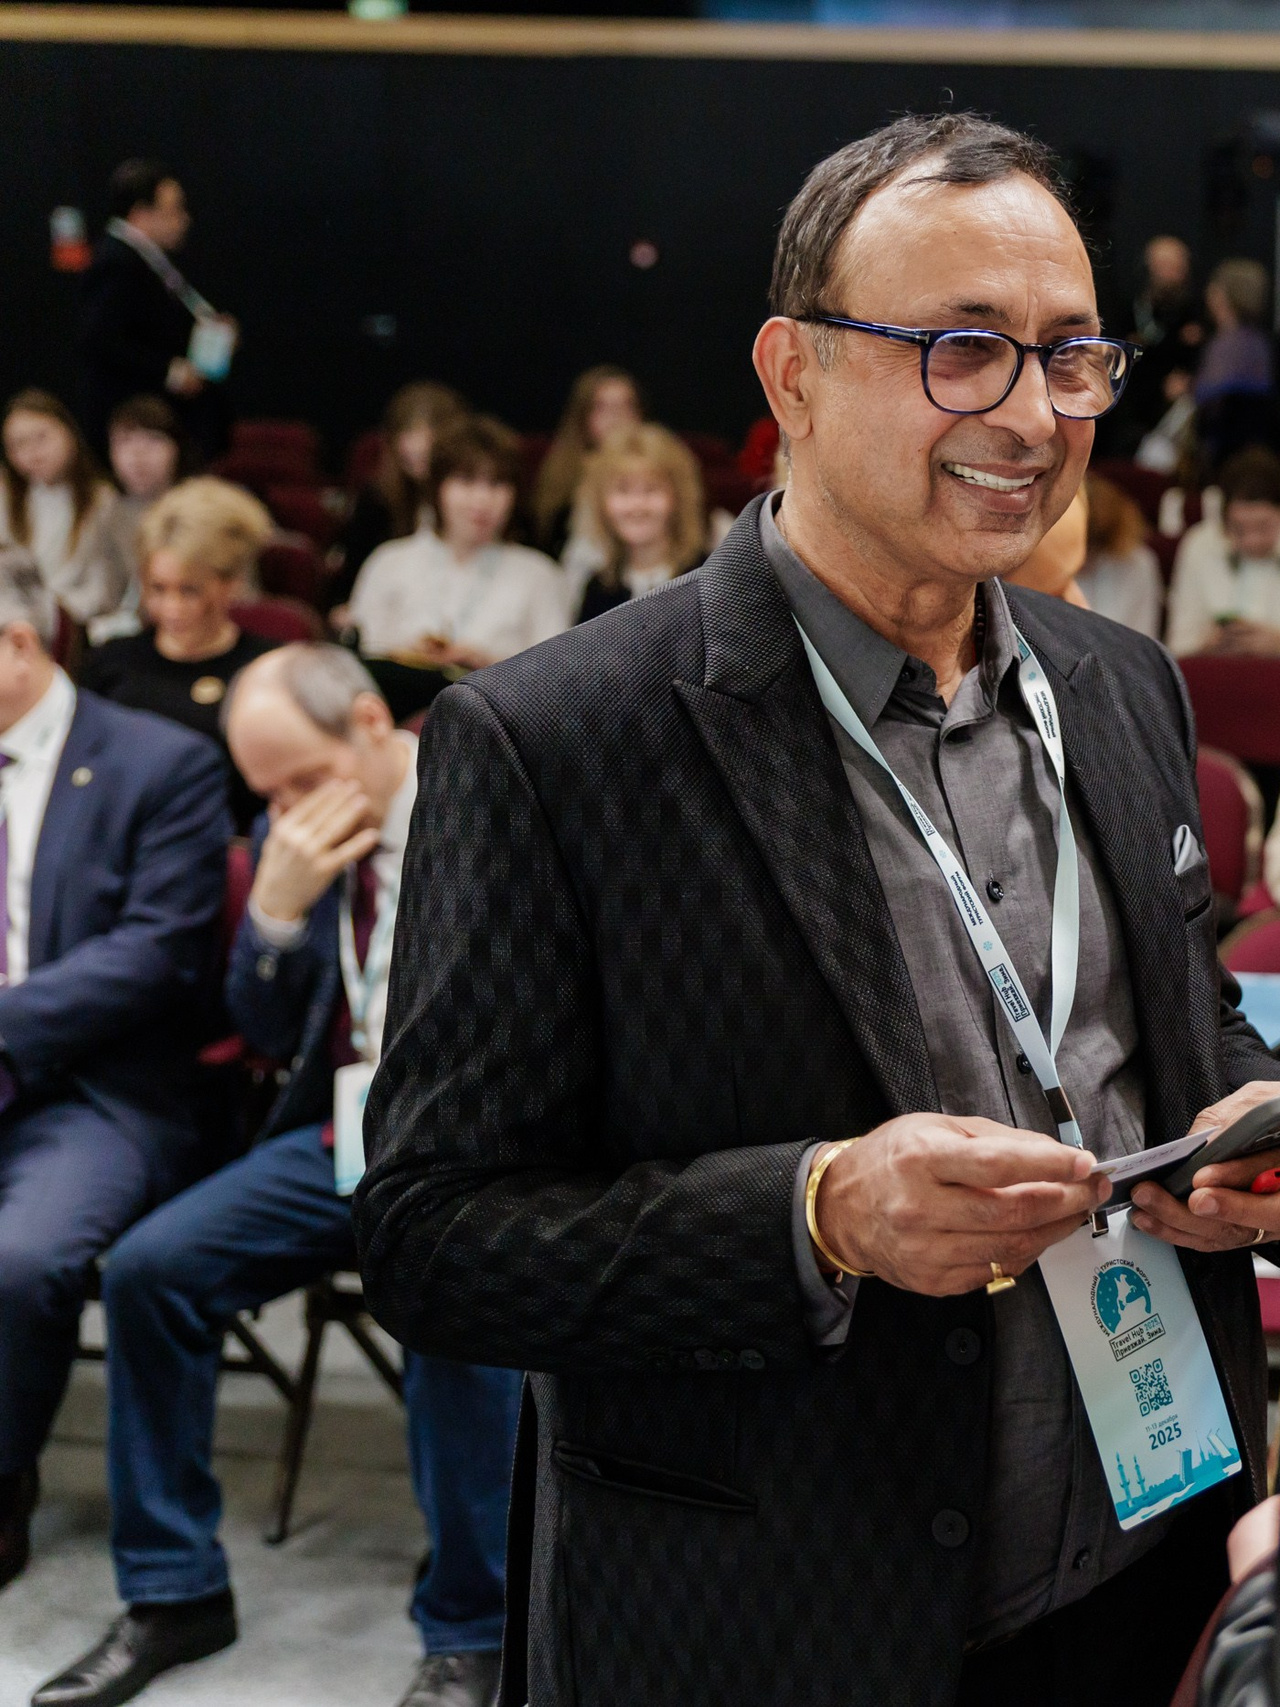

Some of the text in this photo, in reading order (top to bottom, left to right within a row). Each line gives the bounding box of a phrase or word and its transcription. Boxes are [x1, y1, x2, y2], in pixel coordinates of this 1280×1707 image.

[1001, 986, 1012, 1000] Hub
[1007, 999, 1022, 1020] Travel
[1090, 1258, 1152, 1338] МЕЖДУНАРОДНЫЙ ТУРИСТСКИЙ ФОРУМ
[1111, 1333, 1132, 1350] Travel
[1131, 1327, 1145, 1339] Hub
[1148, 1421, 1182, 1451] 2025
